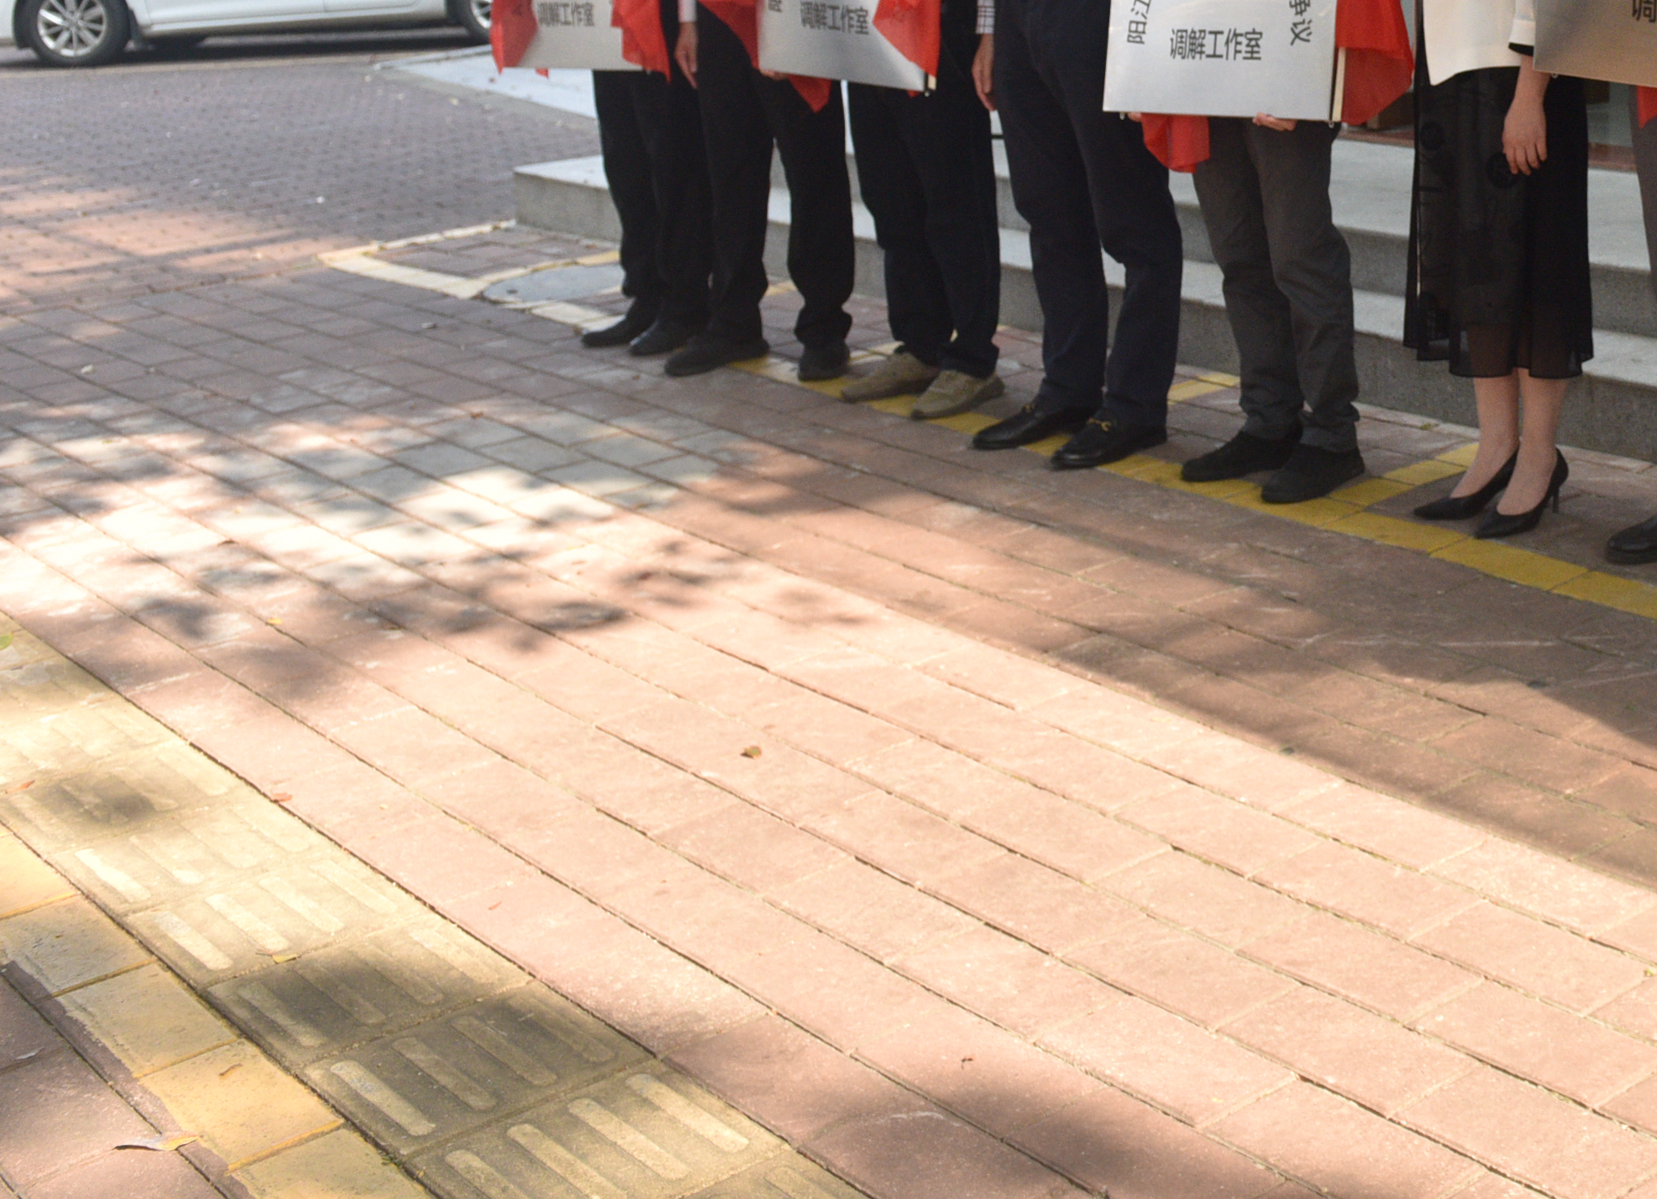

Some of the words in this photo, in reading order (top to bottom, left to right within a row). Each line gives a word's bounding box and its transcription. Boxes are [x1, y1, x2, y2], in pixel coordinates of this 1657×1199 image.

[537, 1, 595, 28] 调解工作室
[800, 0, 870, 35] 调解工作室
[1169, 27, 1263, 61] 调解工作室
